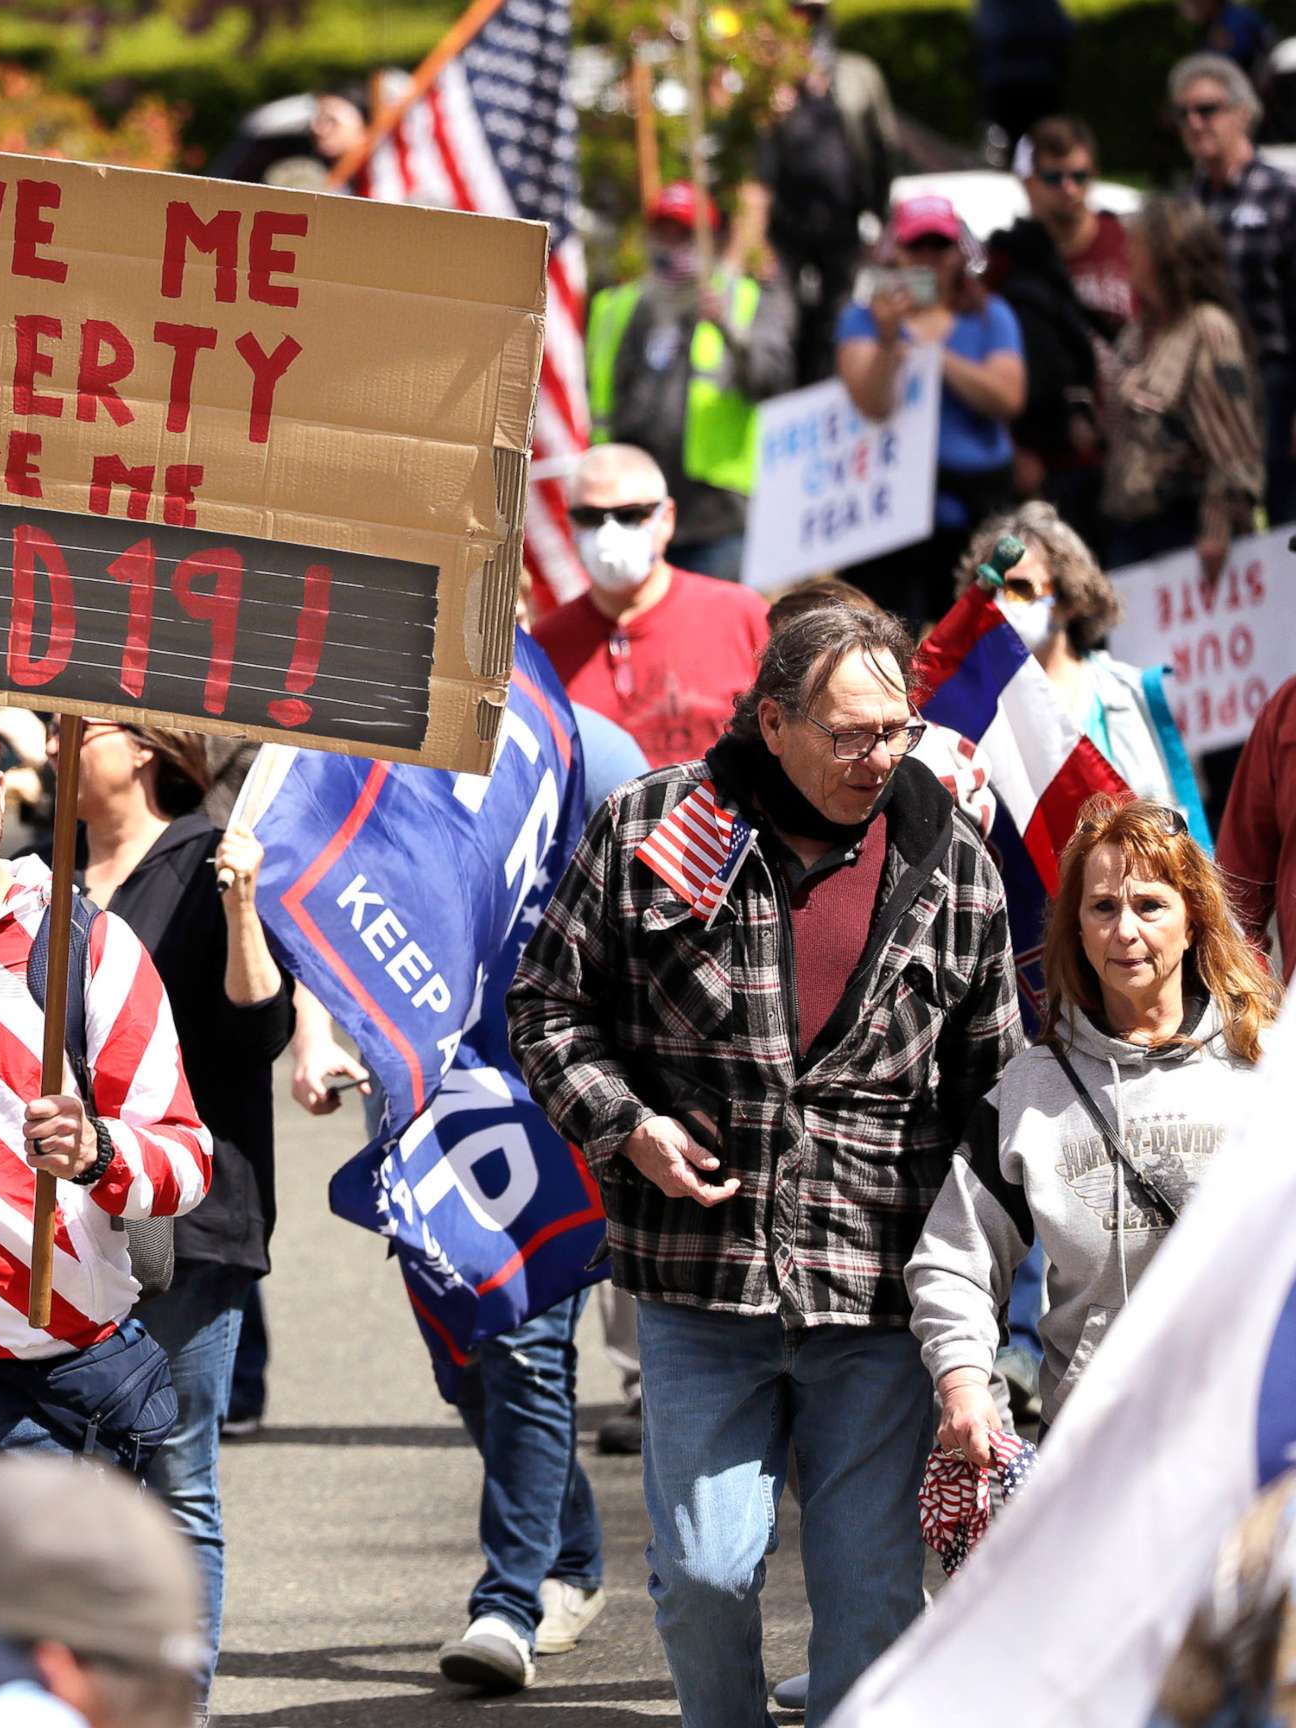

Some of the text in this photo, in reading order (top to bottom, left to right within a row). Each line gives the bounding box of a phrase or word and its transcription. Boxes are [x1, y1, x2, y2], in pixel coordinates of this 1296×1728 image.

[161, 201, 308, 308] ME
[89, 454, 204, 527] ME
[1171, 622, 1254, 685] OUR
[336, 873, 453, 1018] KEEP
